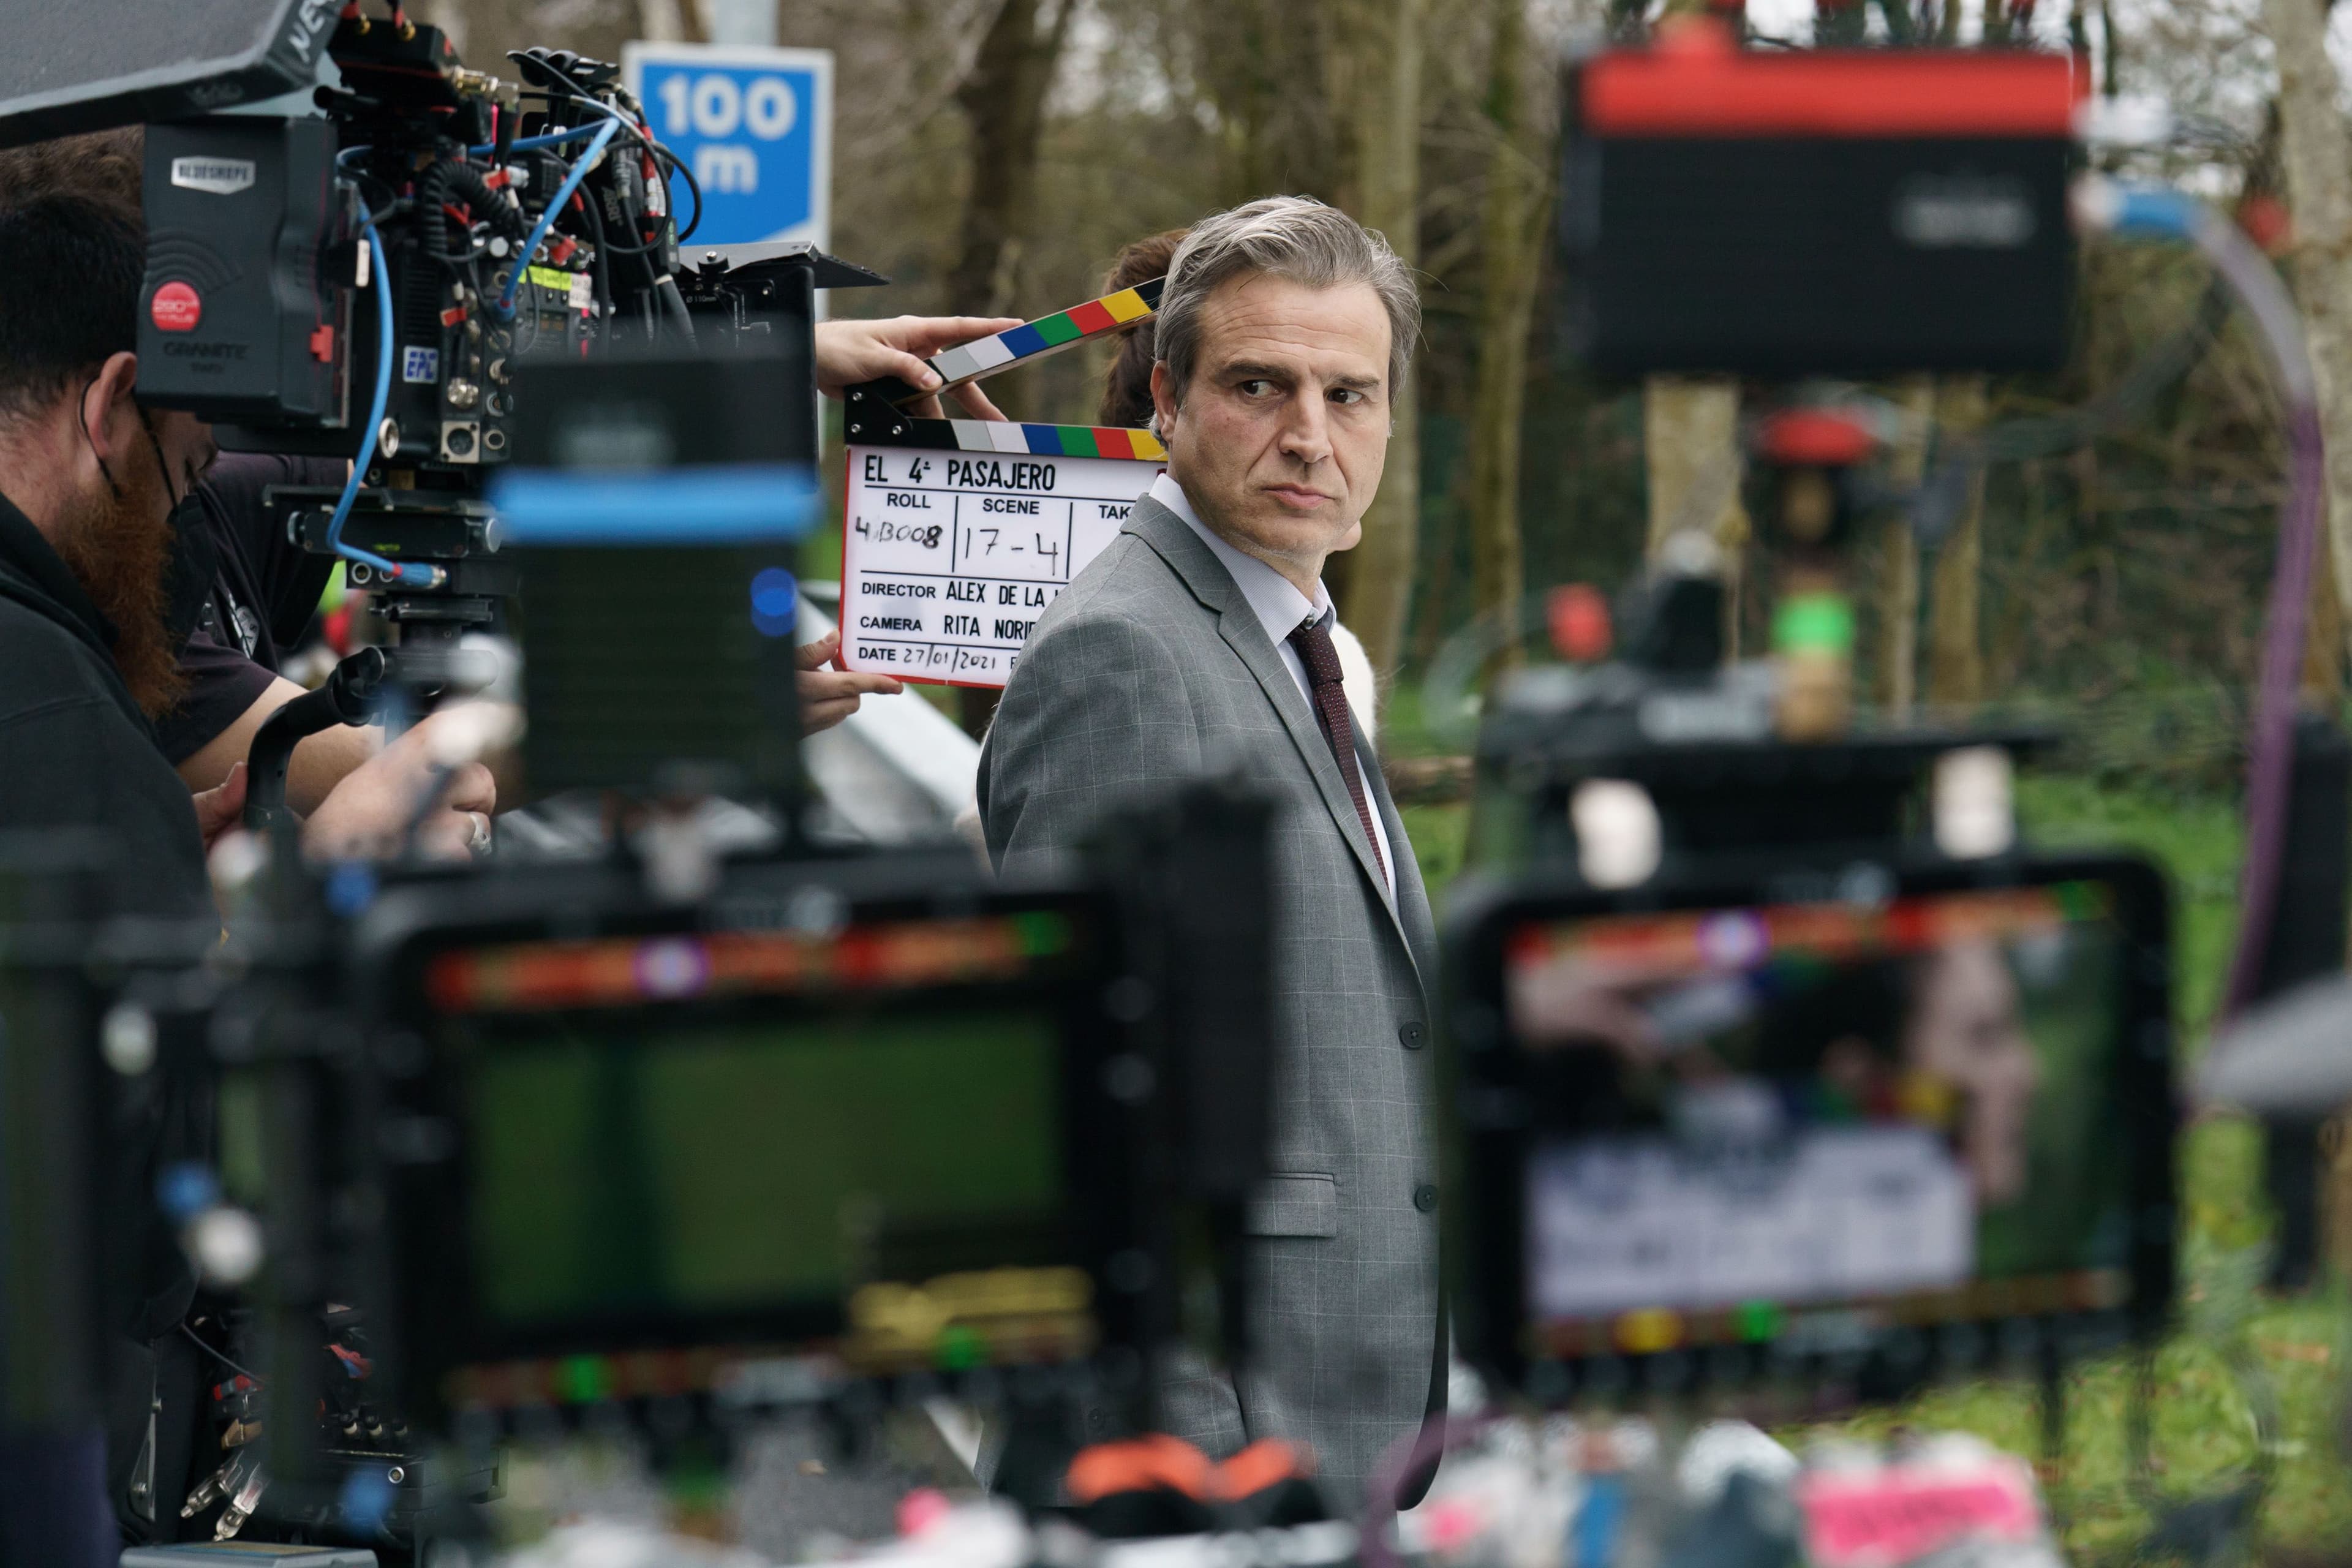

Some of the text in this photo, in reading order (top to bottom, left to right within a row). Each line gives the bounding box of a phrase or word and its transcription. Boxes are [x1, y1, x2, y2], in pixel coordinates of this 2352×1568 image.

[659, 72, 797, 140] 100
[695, 143, 759, 194] m
[865, 454, 888, 482] EL
[948, 459, 1055, 491] PASAJERO
[887, 492, 930, 508] ROLL
[982, 499, 1039, 514] SCENE
[1099, 505, 1131, 519] TAK
[862, 581, 1045, 607] DIRECTOR ALEX DE LA
[860, 616, 923, 631] CAMERA
[944, 615, 981, 636] RITA
[859, 647, 896, 661] DATE
[903, 644, 996, 673] 27/01/2021
